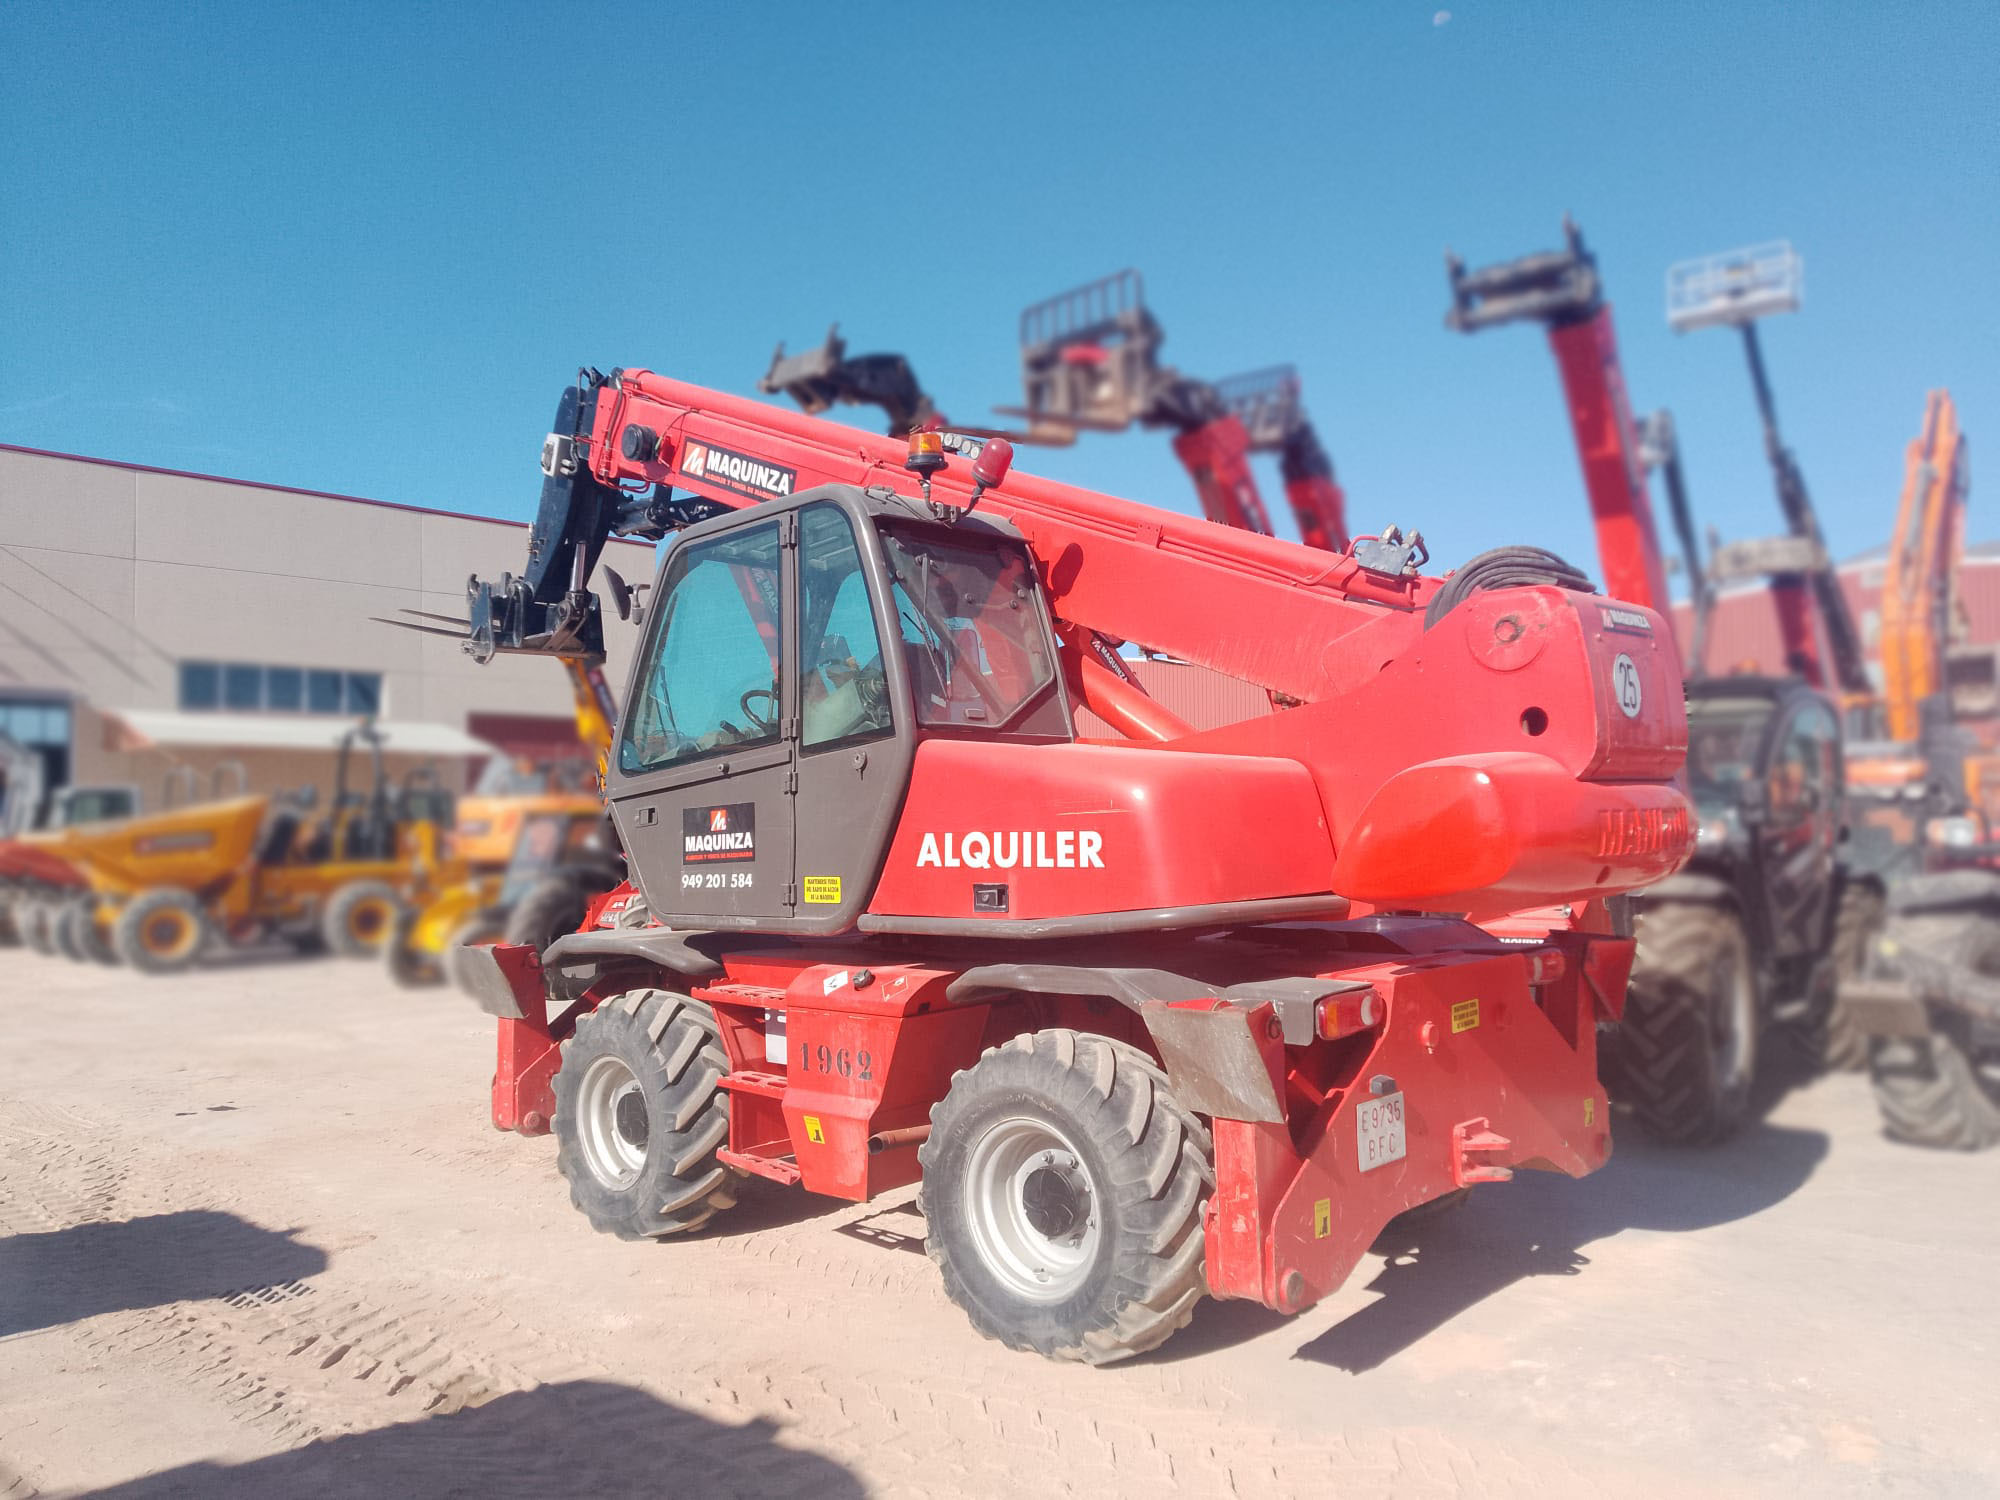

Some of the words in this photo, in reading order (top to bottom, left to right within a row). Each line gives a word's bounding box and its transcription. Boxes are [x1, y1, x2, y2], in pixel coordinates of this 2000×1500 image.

[706, 449, 789, 495] MAQUINZA
[1619, 661, 1638, 710] 25
[685, 831, 753, 852] MAQUINZA
[915, 830, 1106, 869] ALQUILER
[681, 873, 703, 889] 949
[705, 873, 727, 889] 201
[730, 872, 753, 888] 584
[801, 1042, 872, 1081] 1962
[1371, 1100, 1401, 1129] 9735
[1368, 1132, 1396, 1161] BFC
